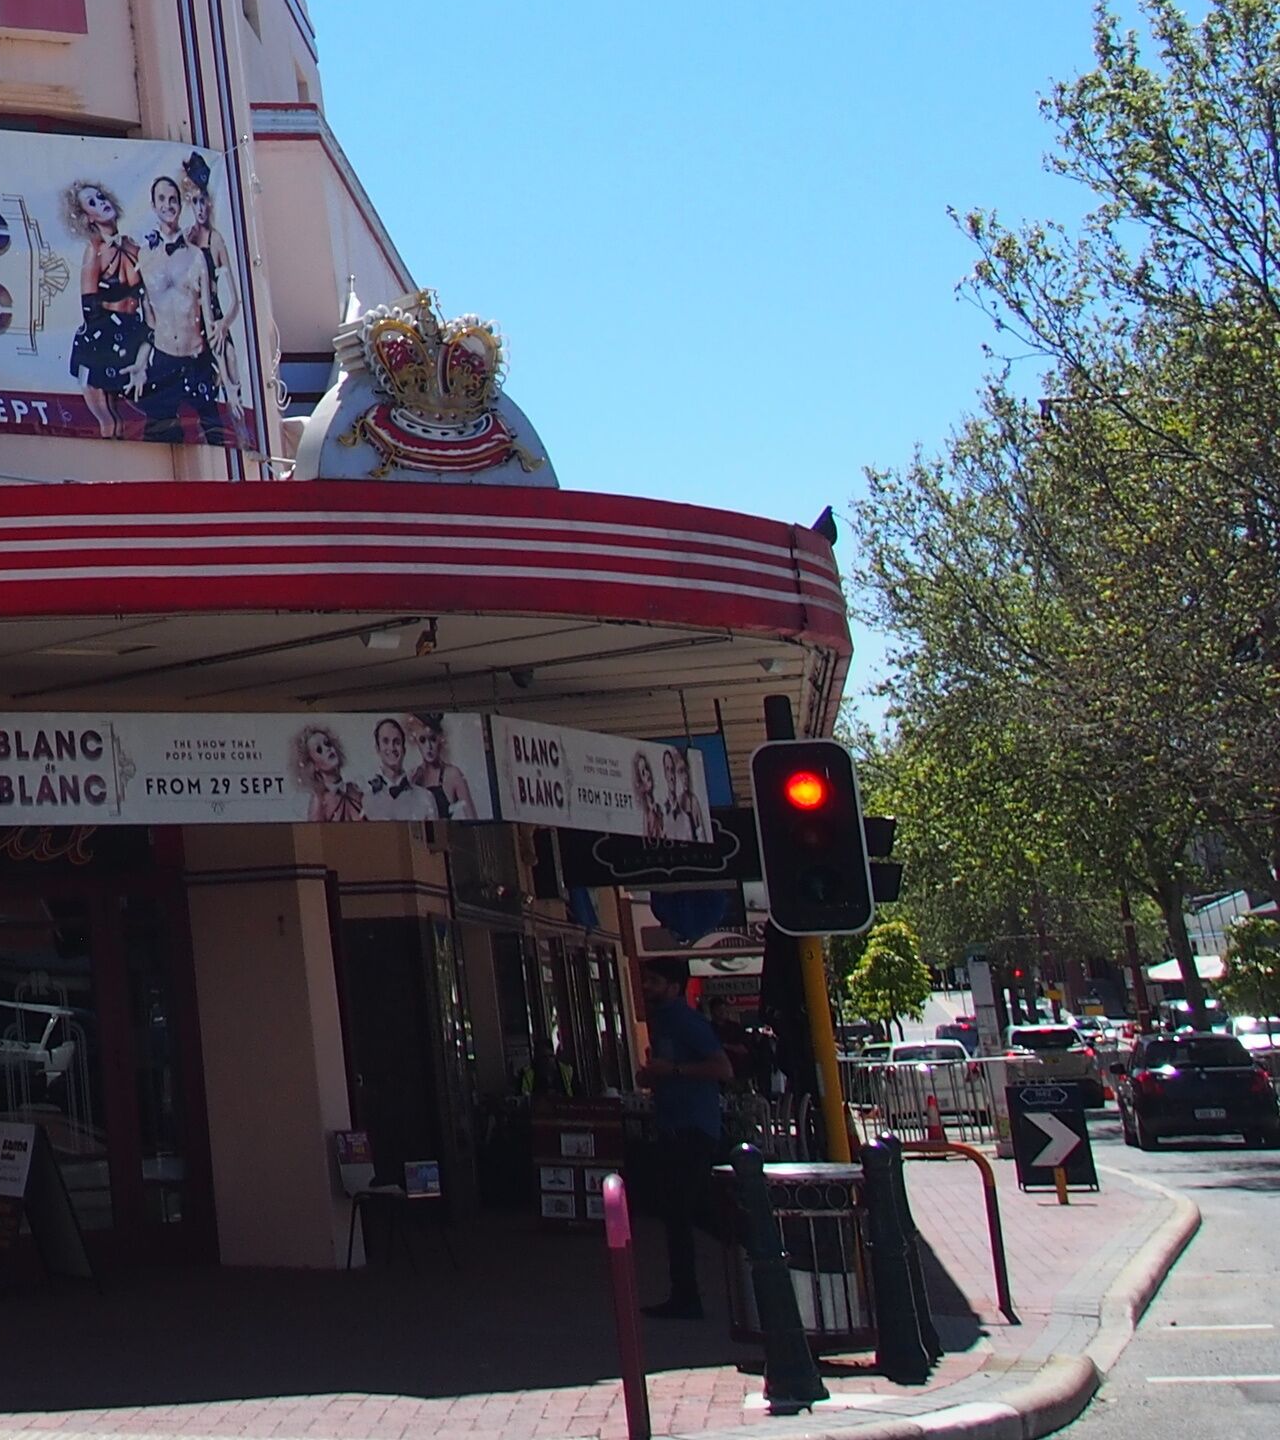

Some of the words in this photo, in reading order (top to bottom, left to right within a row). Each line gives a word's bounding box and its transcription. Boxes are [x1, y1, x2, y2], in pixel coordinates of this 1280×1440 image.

[173, 740, 191, 749] THE
[196, 740, 226, 749] SHOW
[232, 740, 256, 749] THAT
[513, 734, 559, 768] BLANC
[165, 752, 193, 760] POPS
[198, 752, 226, 760] YOUR
[145, 778, 201, 795] FROM
[210, 777, 231, 795] 29
[240, 777, 284, 794] SEPT
[518, 776, 564, 808] BLANC
[578, 787, 601, 805] FROM
[615, 792, 633, 809] SEPT
